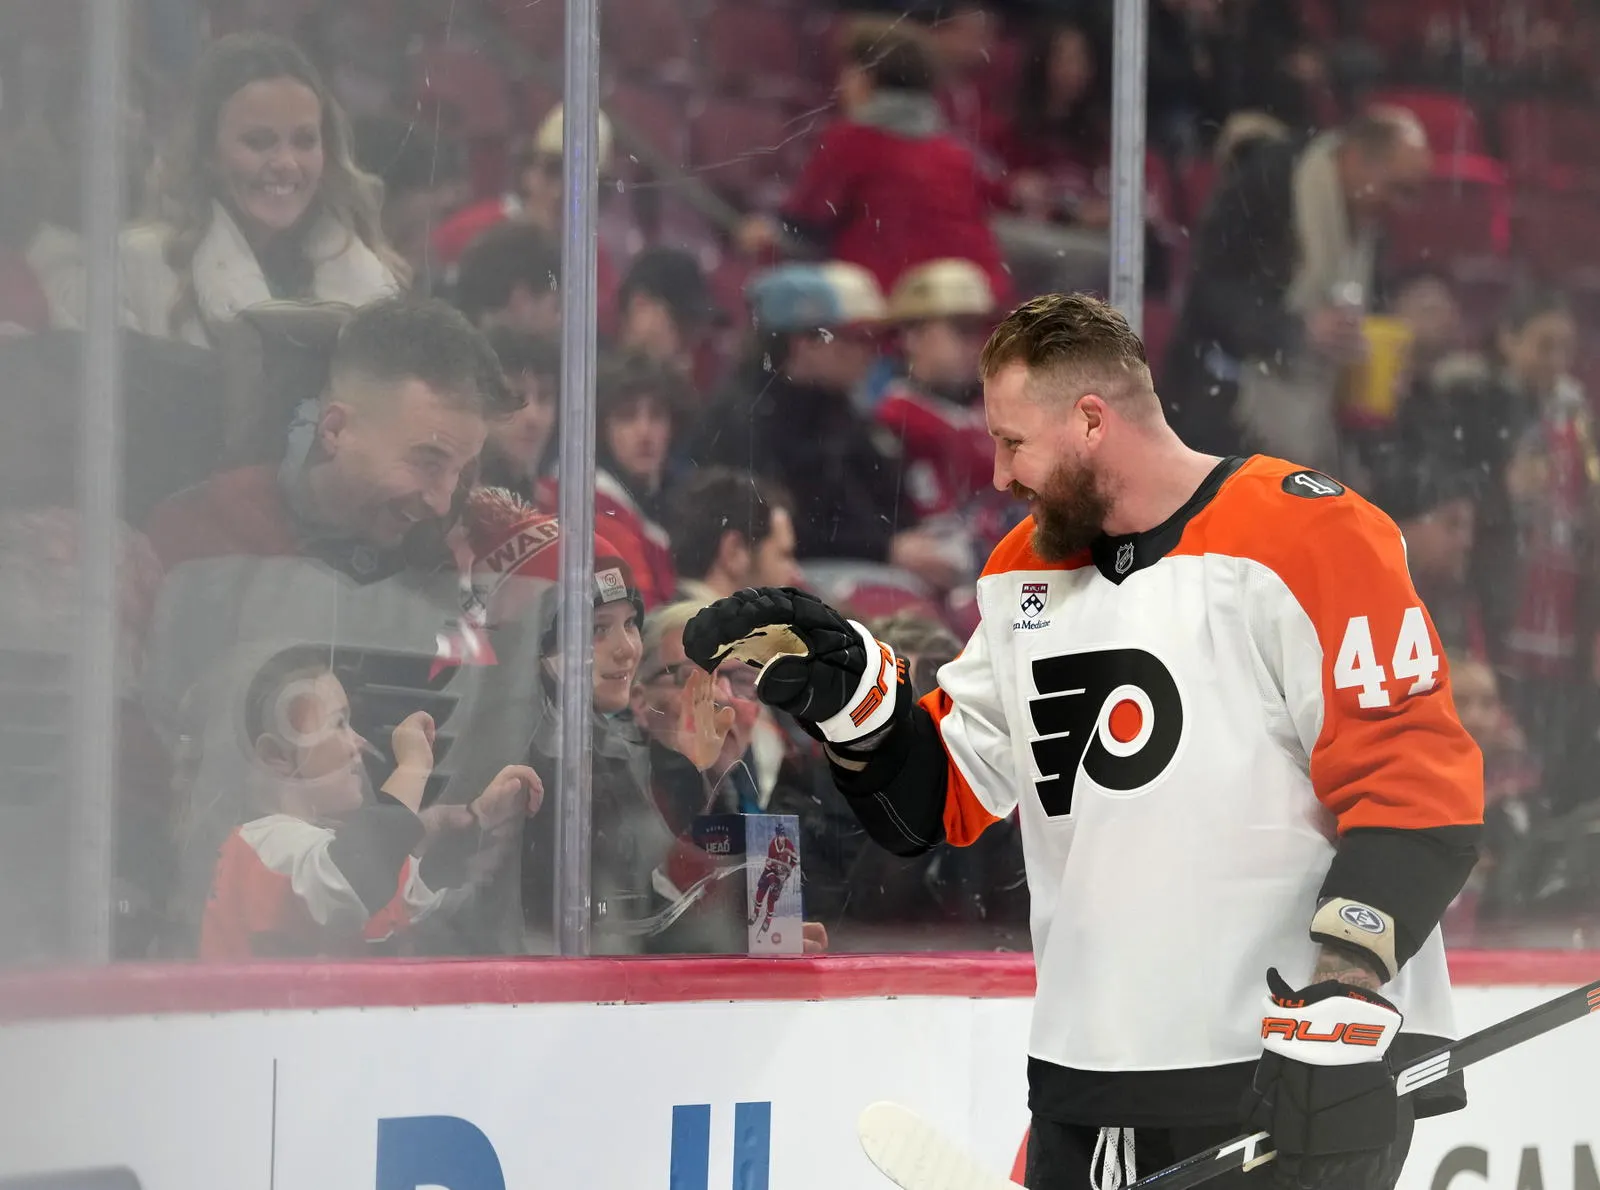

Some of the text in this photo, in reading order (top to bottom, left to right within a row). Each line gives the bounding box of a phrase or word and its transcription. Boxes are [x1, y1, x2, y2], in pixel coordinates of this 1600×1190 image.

[1295, 474, 1336, 494] 1
[1333, 606, 1439, 709] 44
[1261, 1016, 1386, 1047] RUE
